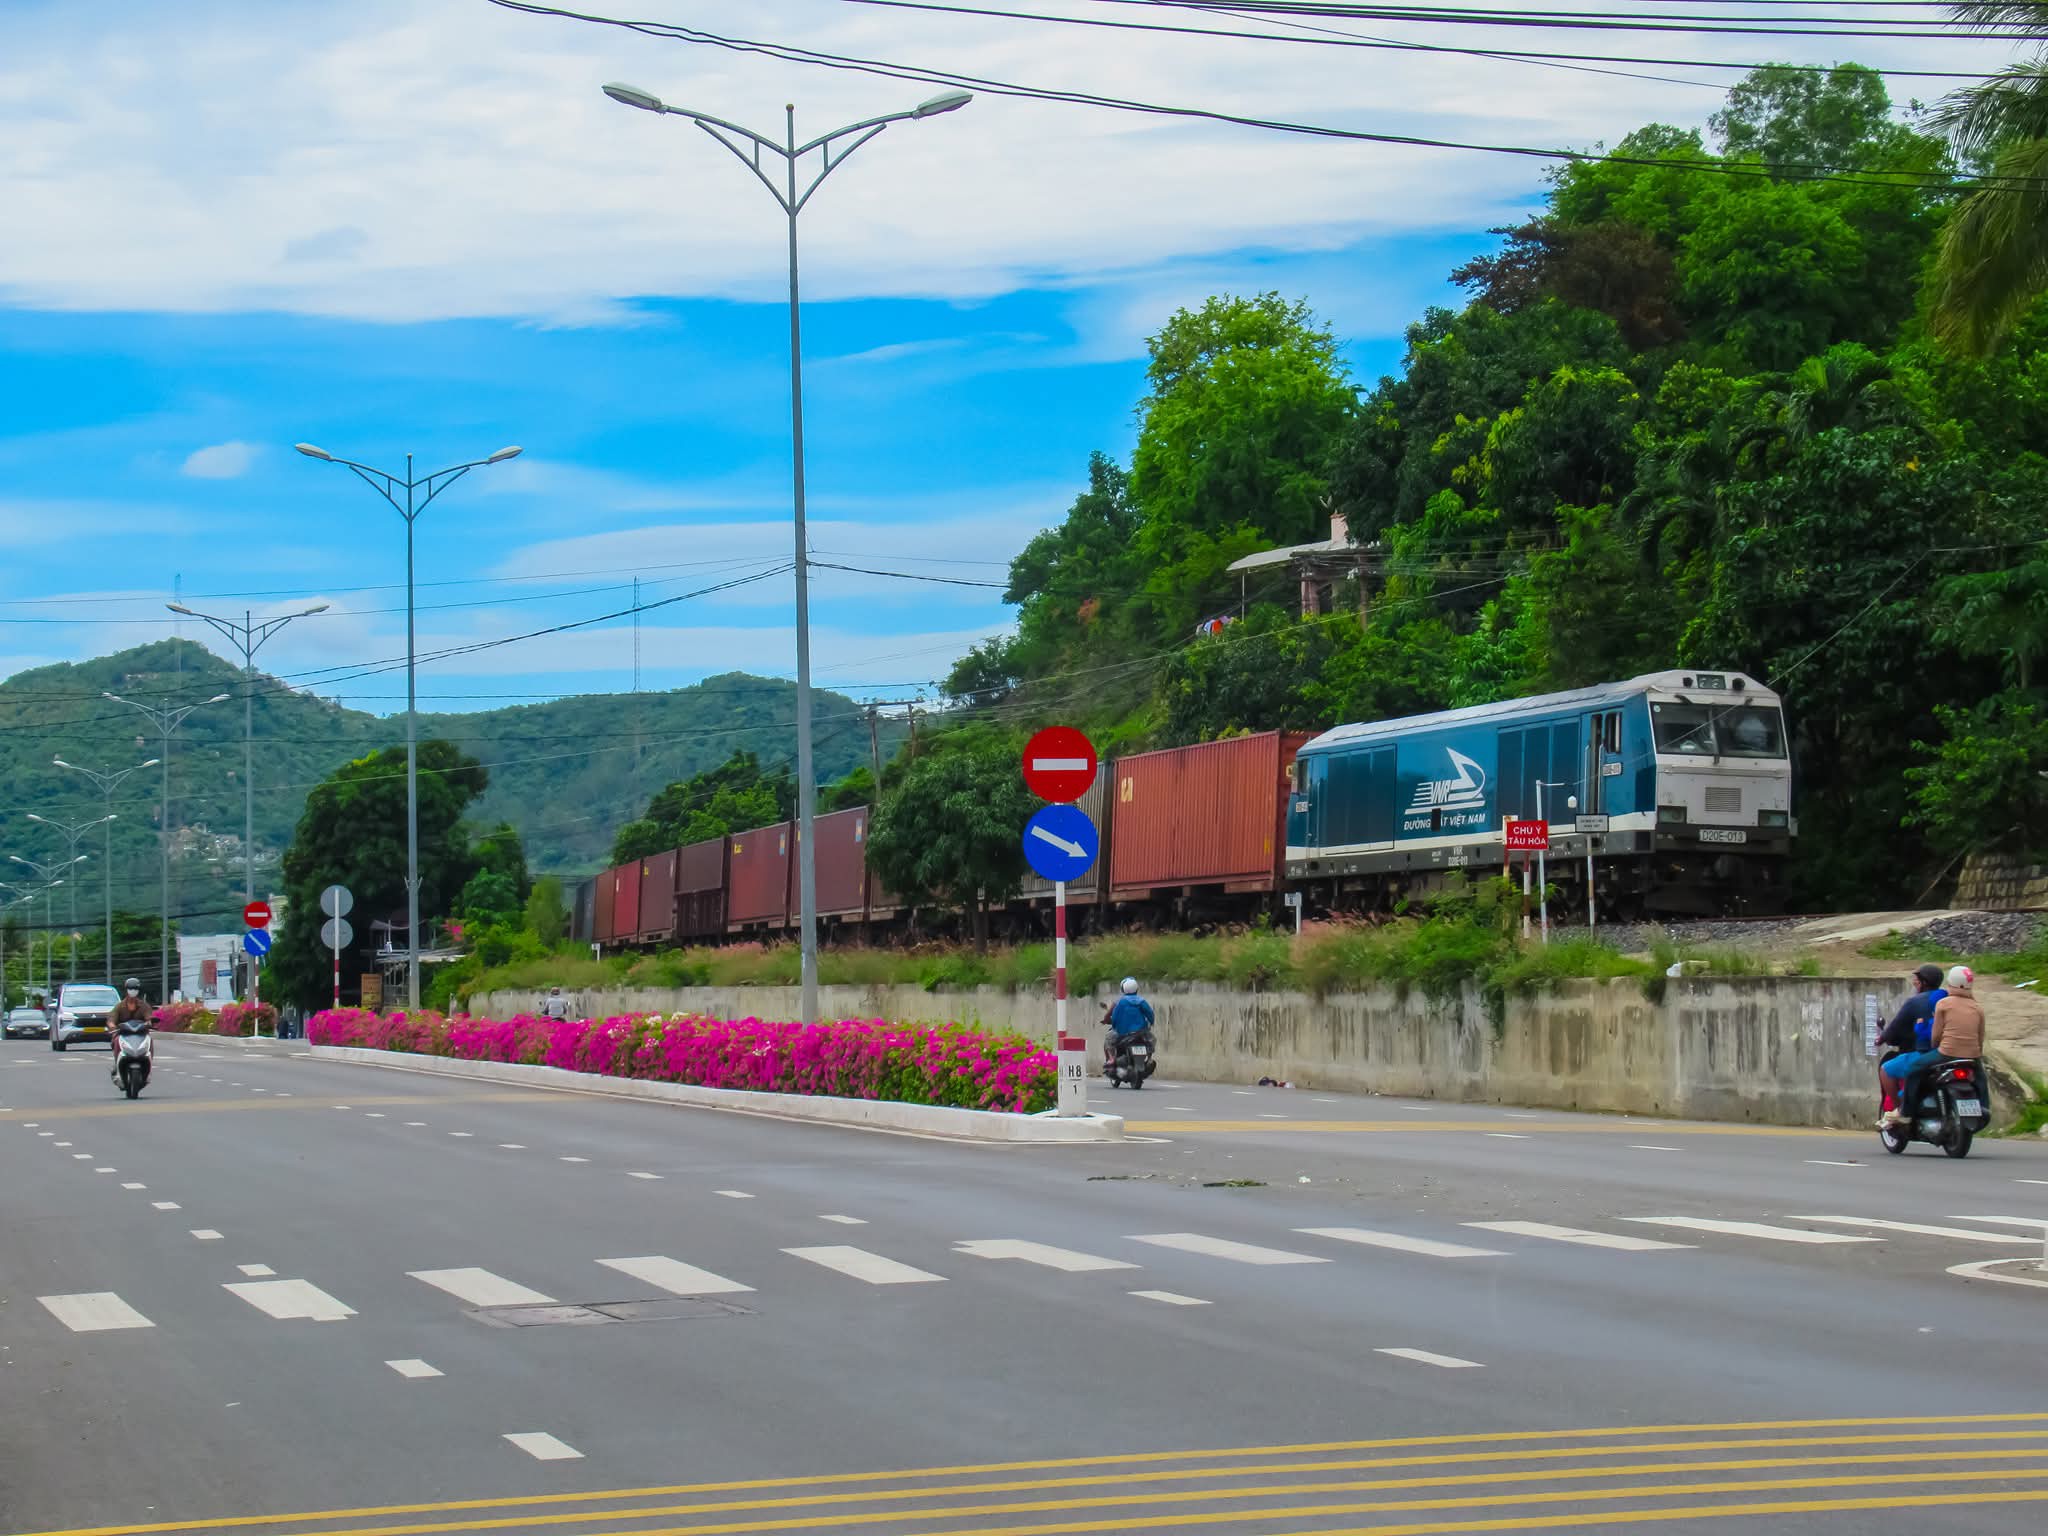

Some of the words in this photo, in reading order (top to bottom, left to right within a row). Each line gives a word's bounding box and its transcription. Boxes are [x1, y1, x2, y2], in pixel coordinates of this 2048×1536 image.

[1468, 813, 1486, 825] NAM
[1703, 831, 1744, 841] D20E-013
[1068, 1065, 1082, 1078] H8
[1073, 1085, 1078, 1095] 1
